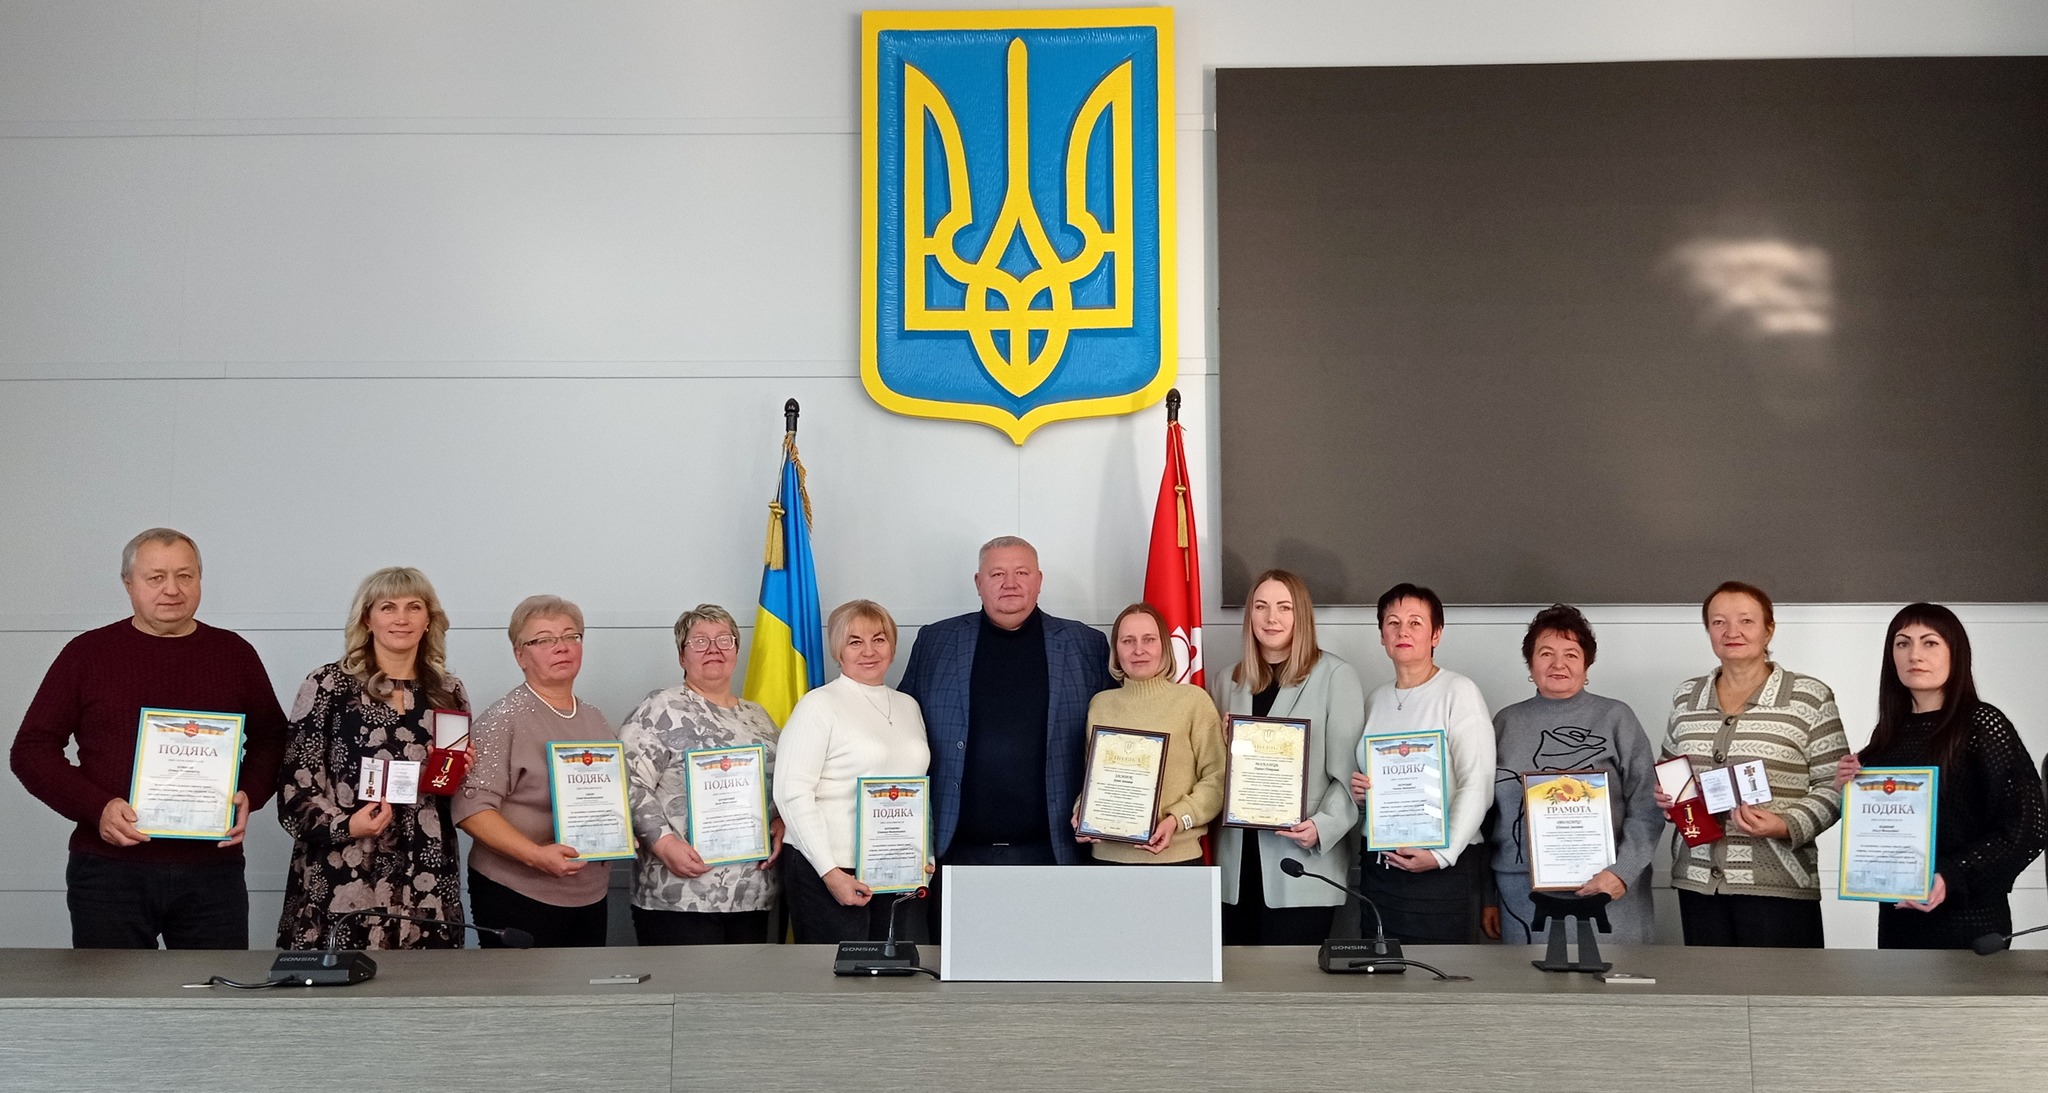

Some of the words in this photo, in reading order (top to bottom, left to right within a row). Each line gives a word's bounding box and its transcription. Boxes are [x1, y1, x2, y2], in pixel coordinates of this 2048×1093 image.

[158, 743, 218, 757] ПОДЯКА
[567, 773, 611, 785] ПОДЯКА
[704, 778, 750, 790] ПОДЯКА
[873, 808, 914, 819] ПОДЯКА
[1546, 806, 1592, 814] ГРАМОТА
[1862, 803, 1915, 815] ПОДЯКА
